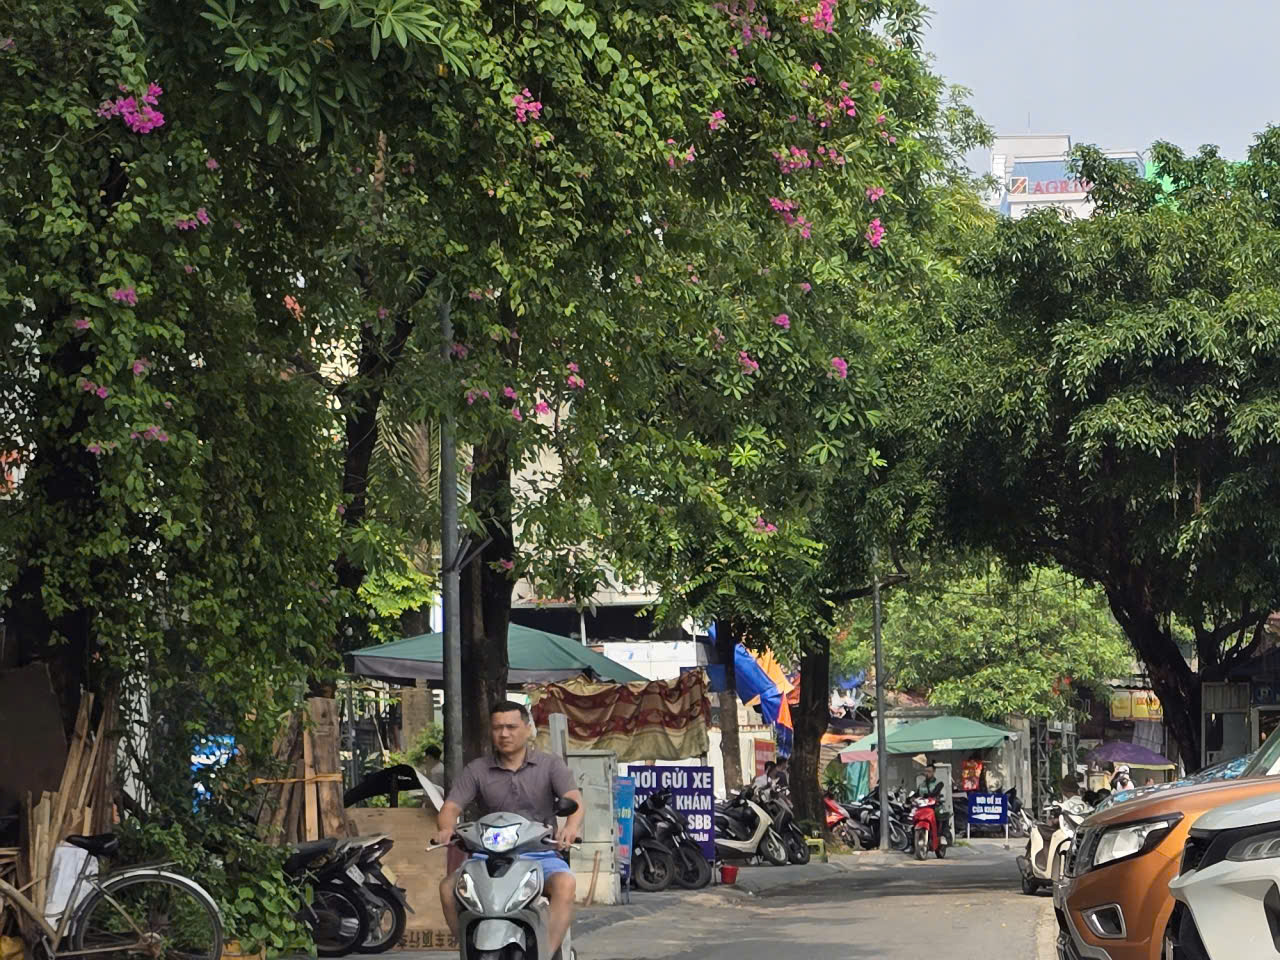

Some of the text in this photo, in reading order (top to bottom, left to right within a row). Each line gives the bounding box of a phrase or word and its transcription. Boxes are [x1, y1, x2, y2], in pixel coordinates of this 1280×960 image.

[630, 769, 657, 788] NƠI
[662, 768, 687, 788] GỬI
[693, 773, 711, 788] XE
[676, 792, 711, 810] KHÁM
[687, 814, 712, 830] SBB
